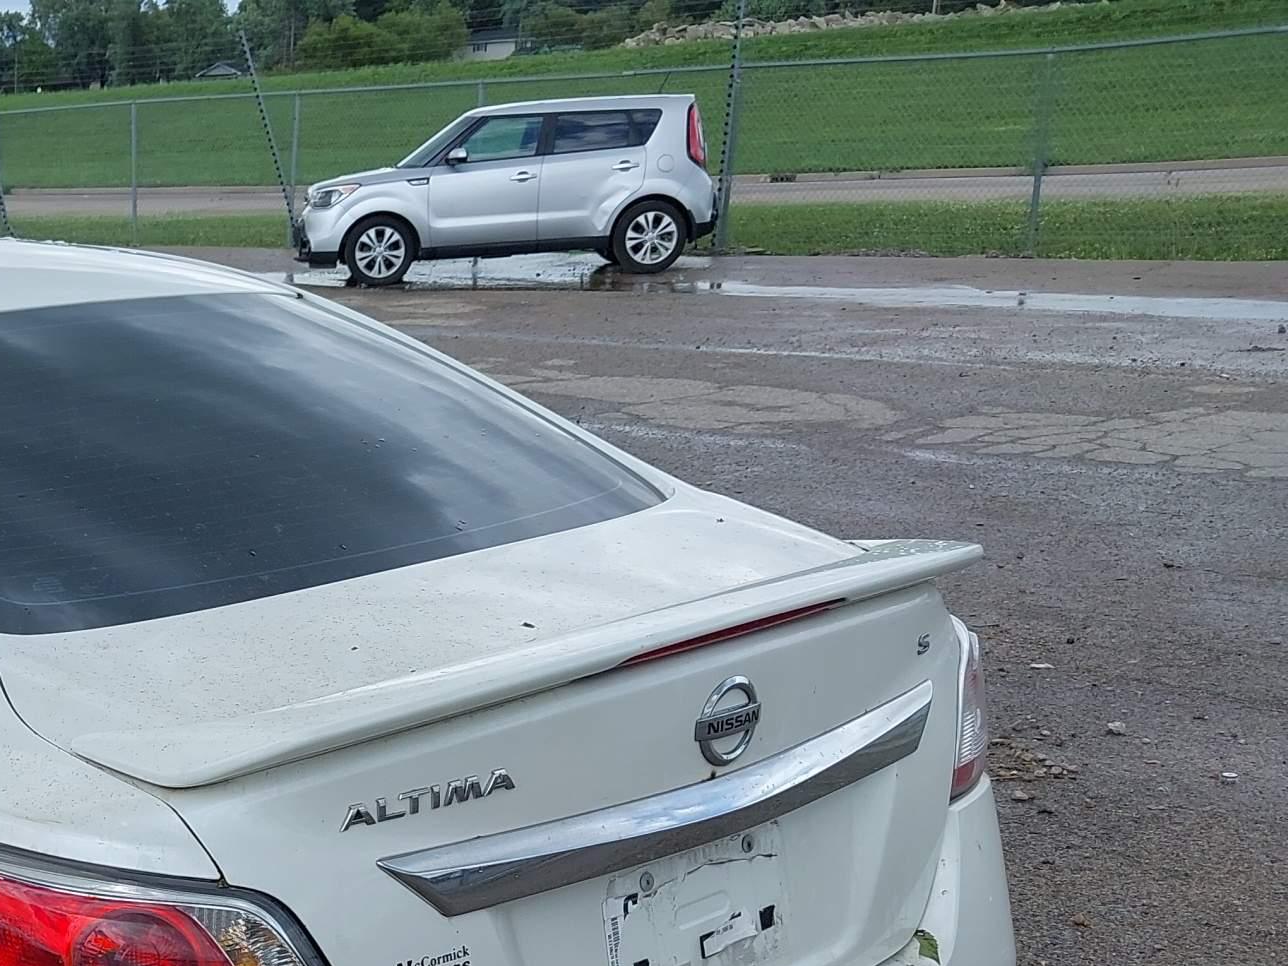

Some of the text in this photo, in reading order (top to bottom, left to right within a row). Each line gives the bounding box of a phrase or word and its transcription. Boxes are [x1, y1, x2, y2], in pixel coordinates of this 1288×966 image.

[917, 632, 930, 656] S
[707, 708, 760, 735] NISSAN
[339, 767, 516, 832] ALTIMA
